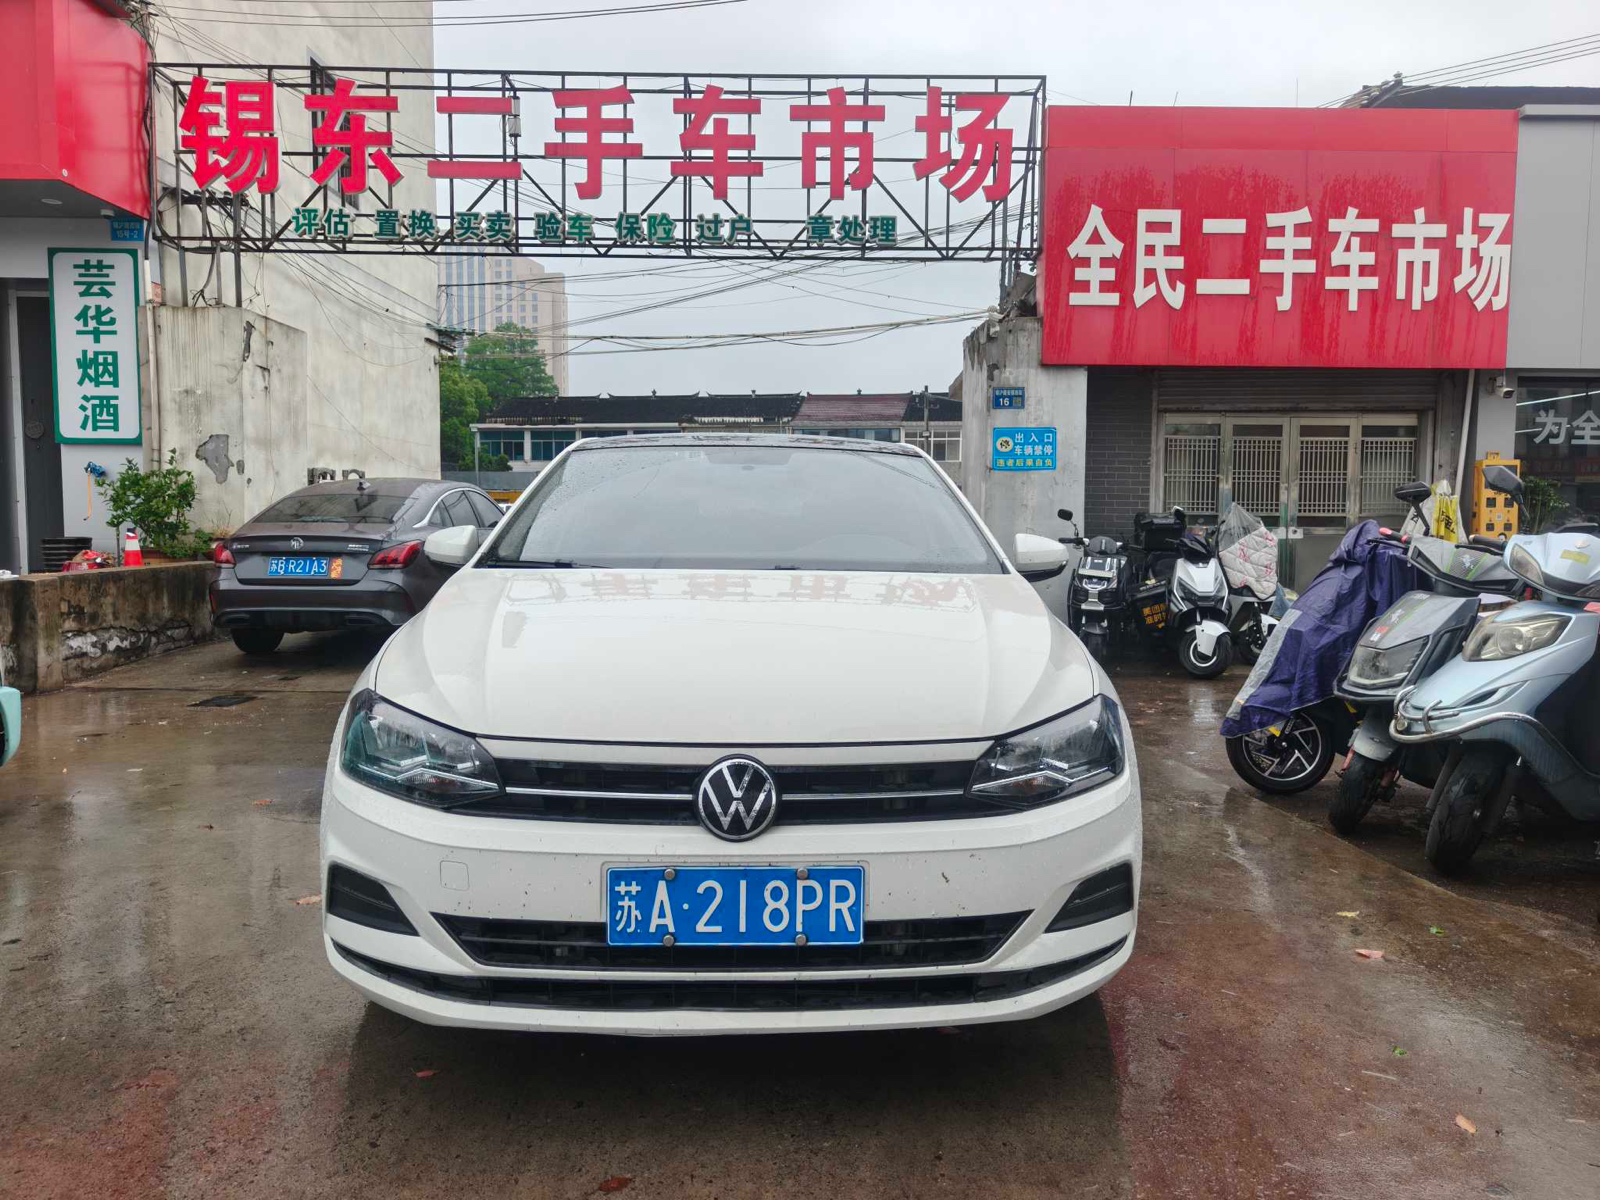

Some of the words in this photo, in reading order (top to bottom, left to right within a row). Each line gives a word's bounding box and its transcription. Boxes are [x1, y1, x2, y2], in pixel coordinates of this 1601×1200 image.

[180, 76, 1014, 203] 锡东二手车市场
[292, 207, 353, 239] 评估
[374, 209, 437, 241] 置换
[454, 211, 515, 243] 买卖
[534, 212, 594, 243] 验车
[615, 212, 676, 244] 保险
[696, 214, 753, 245] 过户
[806, 215, 898, 245] 章处理
[1066, 203, 1512, 312] 全民二手车市场
[73, 259, 119, 432] 芸华烟酒
[999, 397, 1010, 406] 16
[1014, 432, 1053, 443] 出入口
[1533, 409, 1600, 445] 为全
[1014, 445, 1053, 456] 车辆禁停
[614, 878, 857, 934] 苏A·218PR
